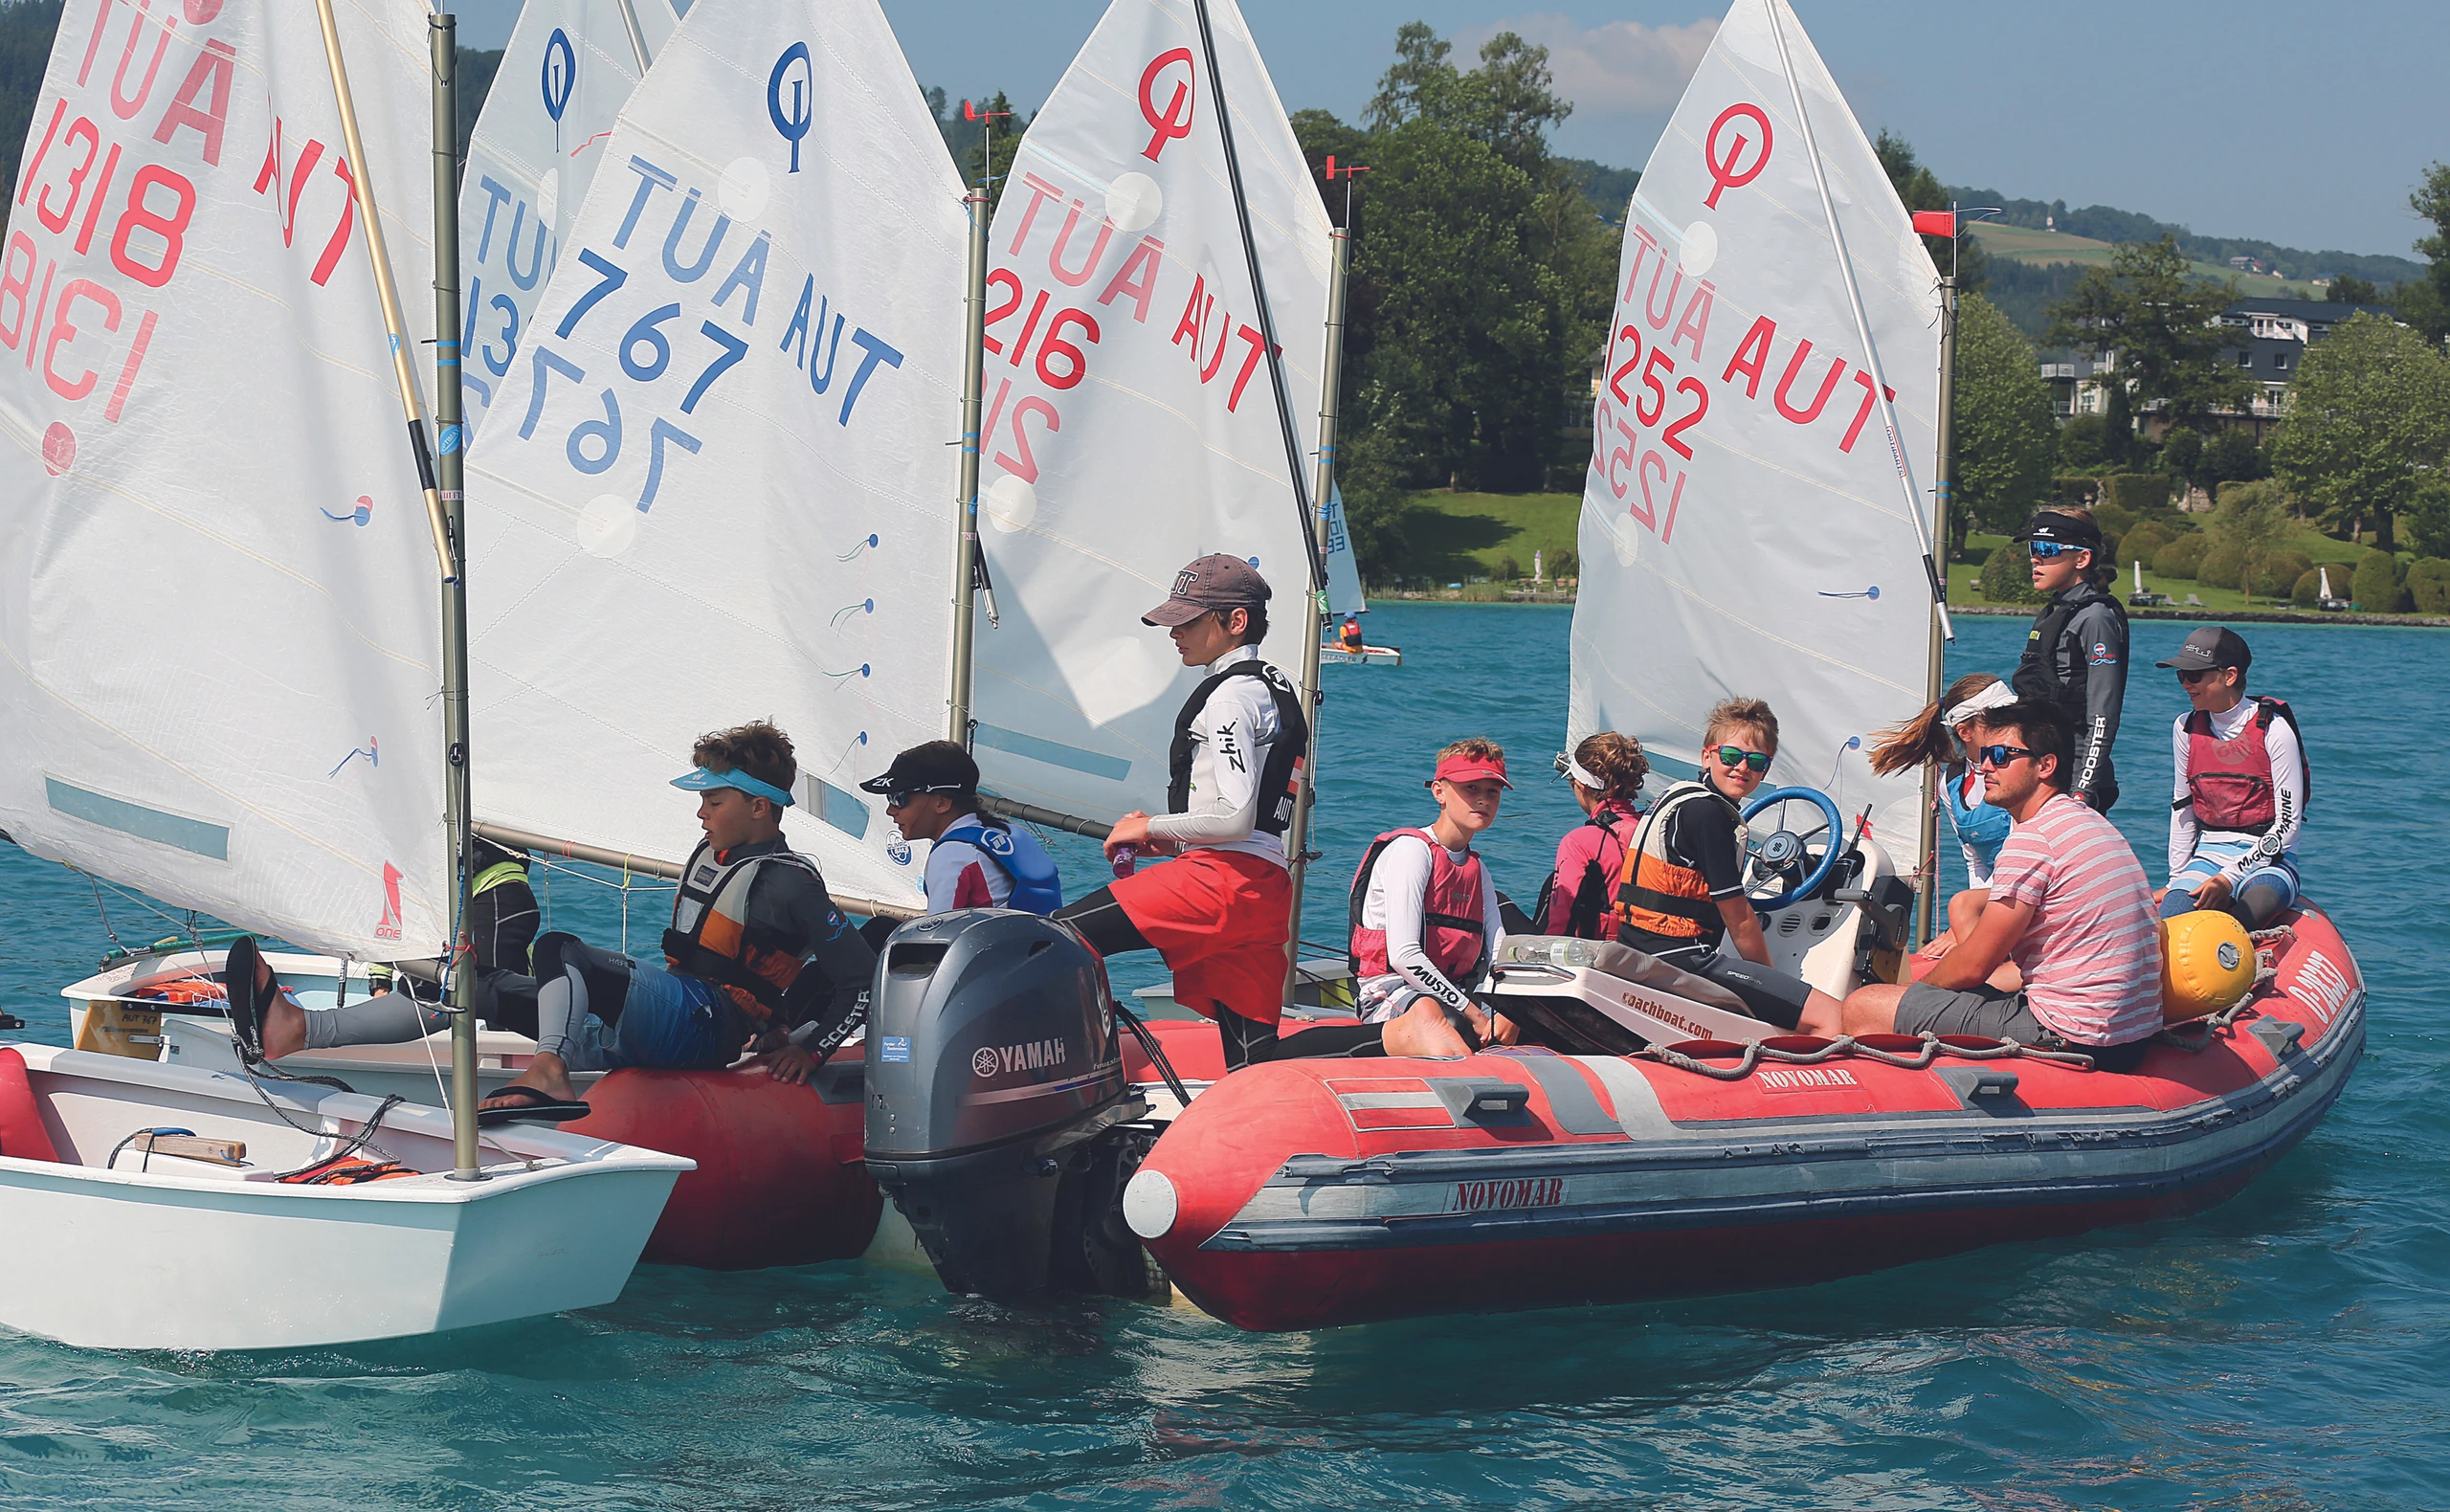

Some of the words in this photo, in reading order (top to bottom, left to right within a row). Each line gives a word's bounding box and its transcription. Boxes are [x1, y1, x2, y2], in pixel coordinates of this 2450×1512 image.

[19, 98, 196, 287] 1318
[555, 248, 748, 414] 767
[779, 273, 904, 427] AUT
[984, 268, 1101, 389] 216
[1170, 273, 1283, 413] AUT
[1722, 314, 1897, 455] AUT
[2078, 716, 2105, 789] ROOSTER
[872, 777, 894, 788] ZK
[1274, 796, 1292, 822] AUT
[2276, 789, 2292, 840] MARINE
[1406, 965, 1459, 1004] MUSTO
[142, 1015, 157, 1024] 767
[1622, 991, 1713, 1039] coachboat.com
[1757, 1068, 1858, 1089] NOVOMAR
[1452, 1177, 1564, 1212] NOVOMAR
